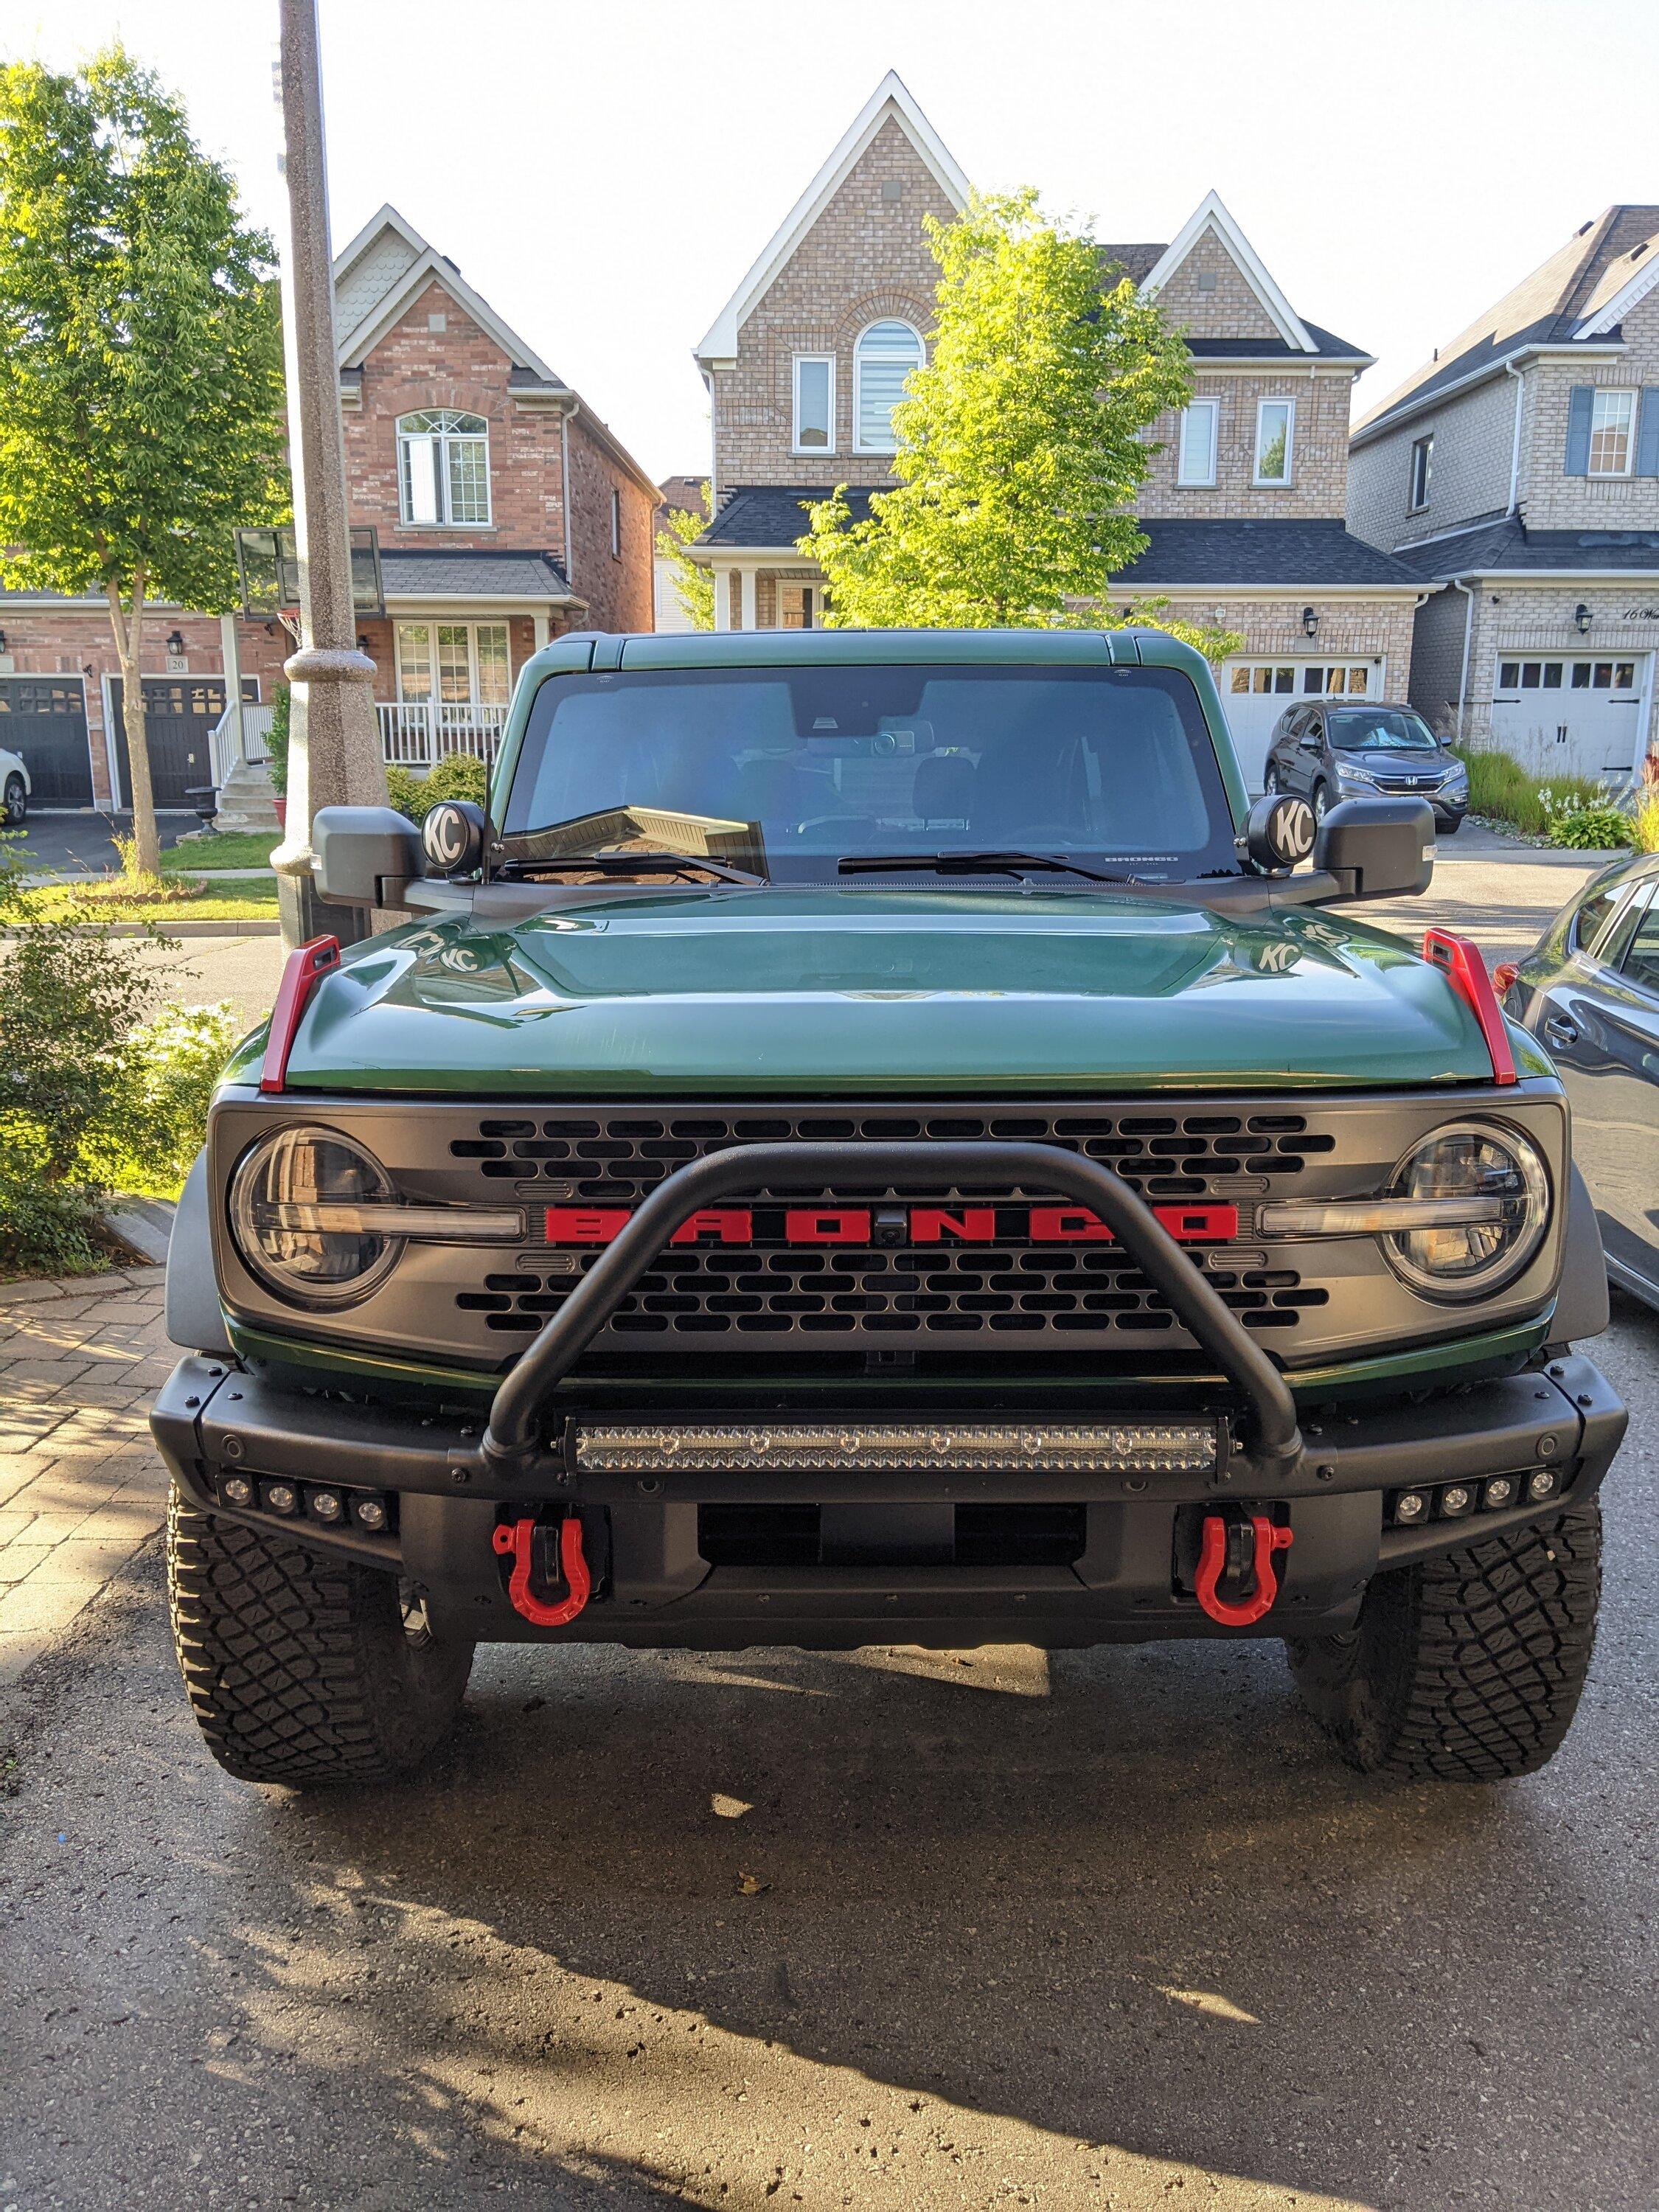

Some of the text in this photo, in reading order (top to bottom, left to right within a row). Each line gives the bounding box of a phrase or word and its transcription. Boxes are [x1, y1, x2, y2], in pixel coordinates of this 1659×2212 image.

[1623, 608, 1638, 620] 16
[173, 660, 184, 669] 20
[425, 807, 461, 863] KC
[1276, 800, 1313, 857] KC
[545, 1205, 1238, 1243] BRONCO
